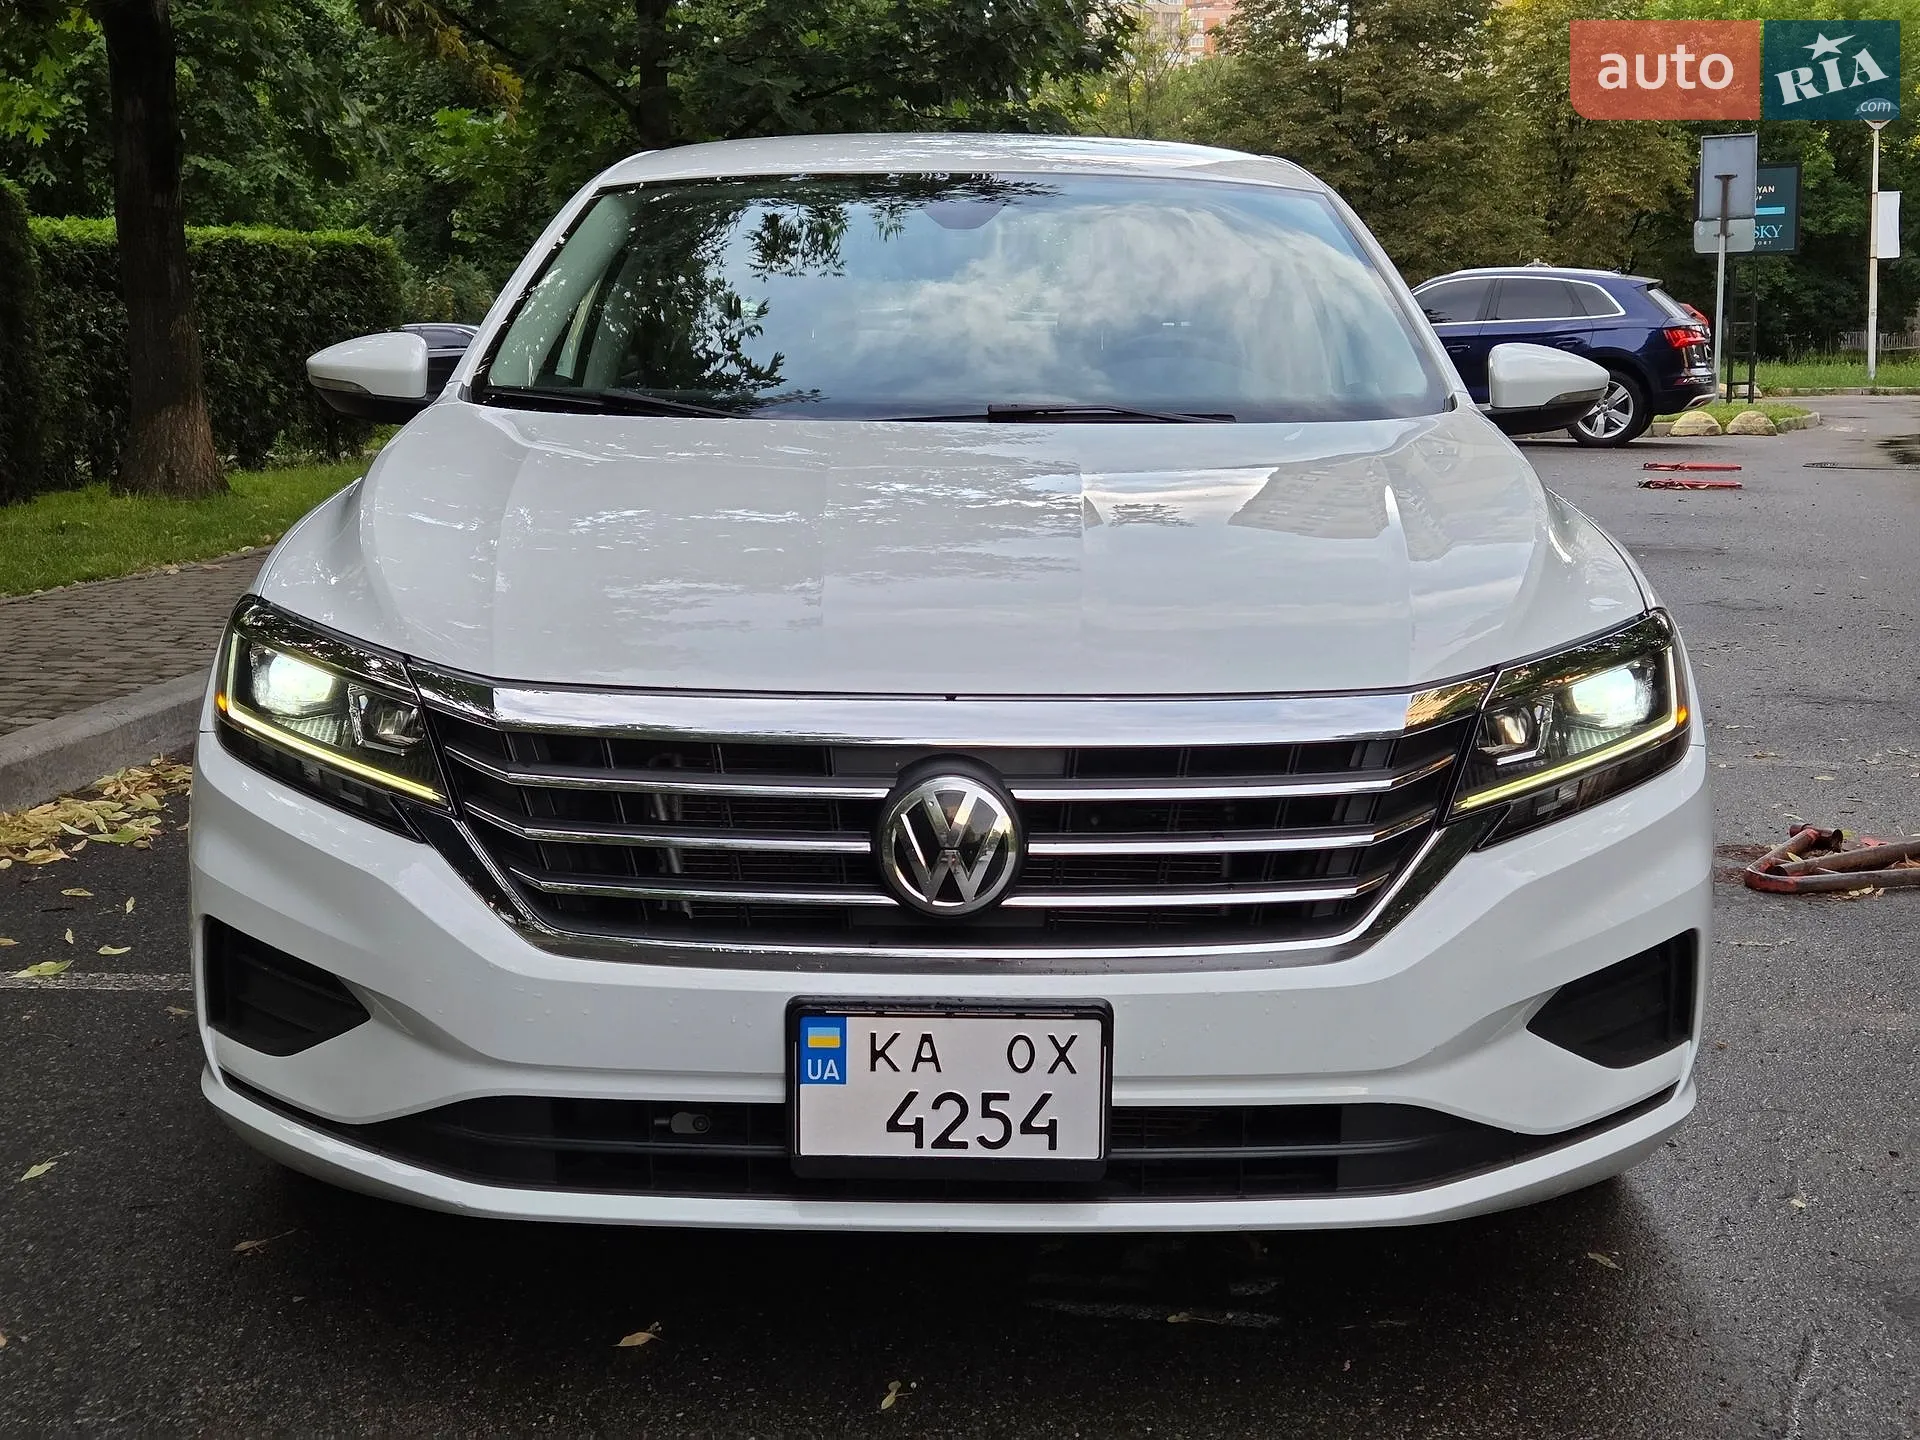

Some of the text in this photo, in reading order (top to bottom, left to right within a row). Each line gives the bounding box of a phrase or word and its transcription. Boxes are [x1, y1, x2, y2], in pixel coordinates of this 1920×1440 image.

[1757, 185, 1775, 194] YAN
[807, 1058, 841, 1081] UA
[869, 1031, 1079, 1075] KA OX
[886, 1090, 1058, 1151] 4254
